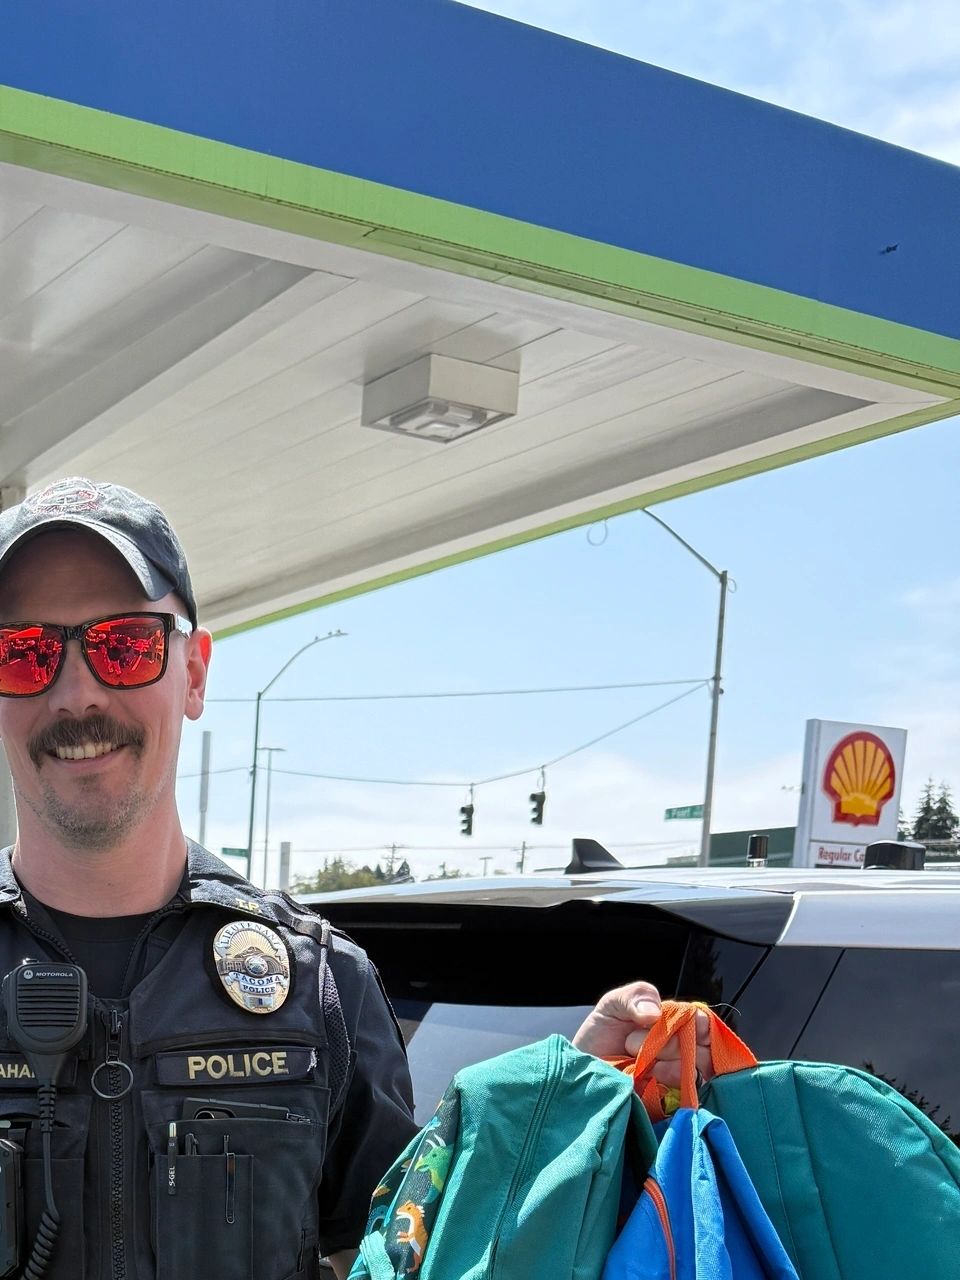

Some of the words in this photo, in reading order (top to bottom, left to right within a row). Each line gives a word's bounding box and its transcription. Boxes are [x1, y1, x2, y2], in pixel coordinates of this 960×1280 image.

[817, 846, 852, 864] Regular
[221, 922, 280, 946] LIEUTENANT
[233, 972, 281, 985] TACOMA
[242, 984, 276, 993] POLICE
[187, 1051, 290, 1080] POLICE
